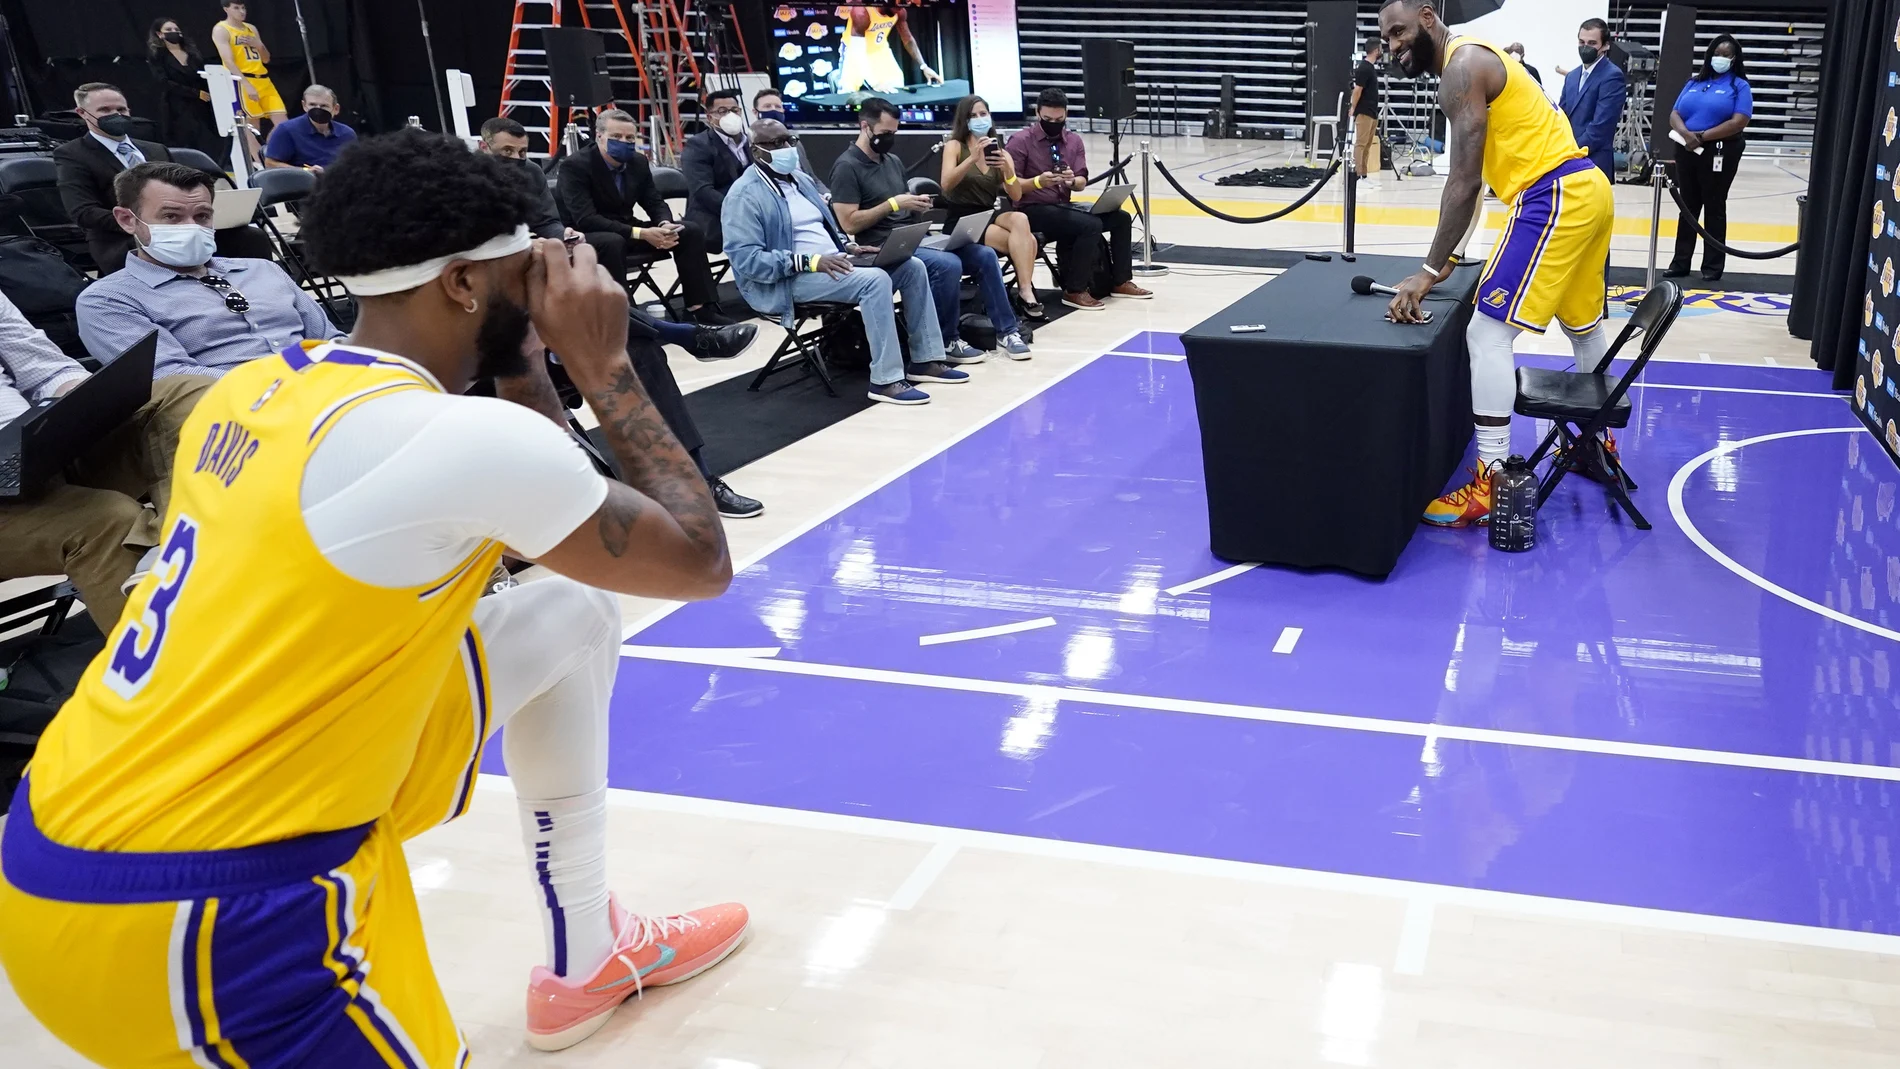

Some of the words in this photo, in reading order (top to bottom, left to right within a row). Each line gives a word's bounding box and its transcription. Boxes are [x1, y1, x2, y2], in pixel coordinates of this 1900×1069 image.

[244, 46, 260, 60] 15
[876, 31, 884, 43] 6
[194, 420, 259, 488] DAVIS
[103, 514, 200, 700] 3
